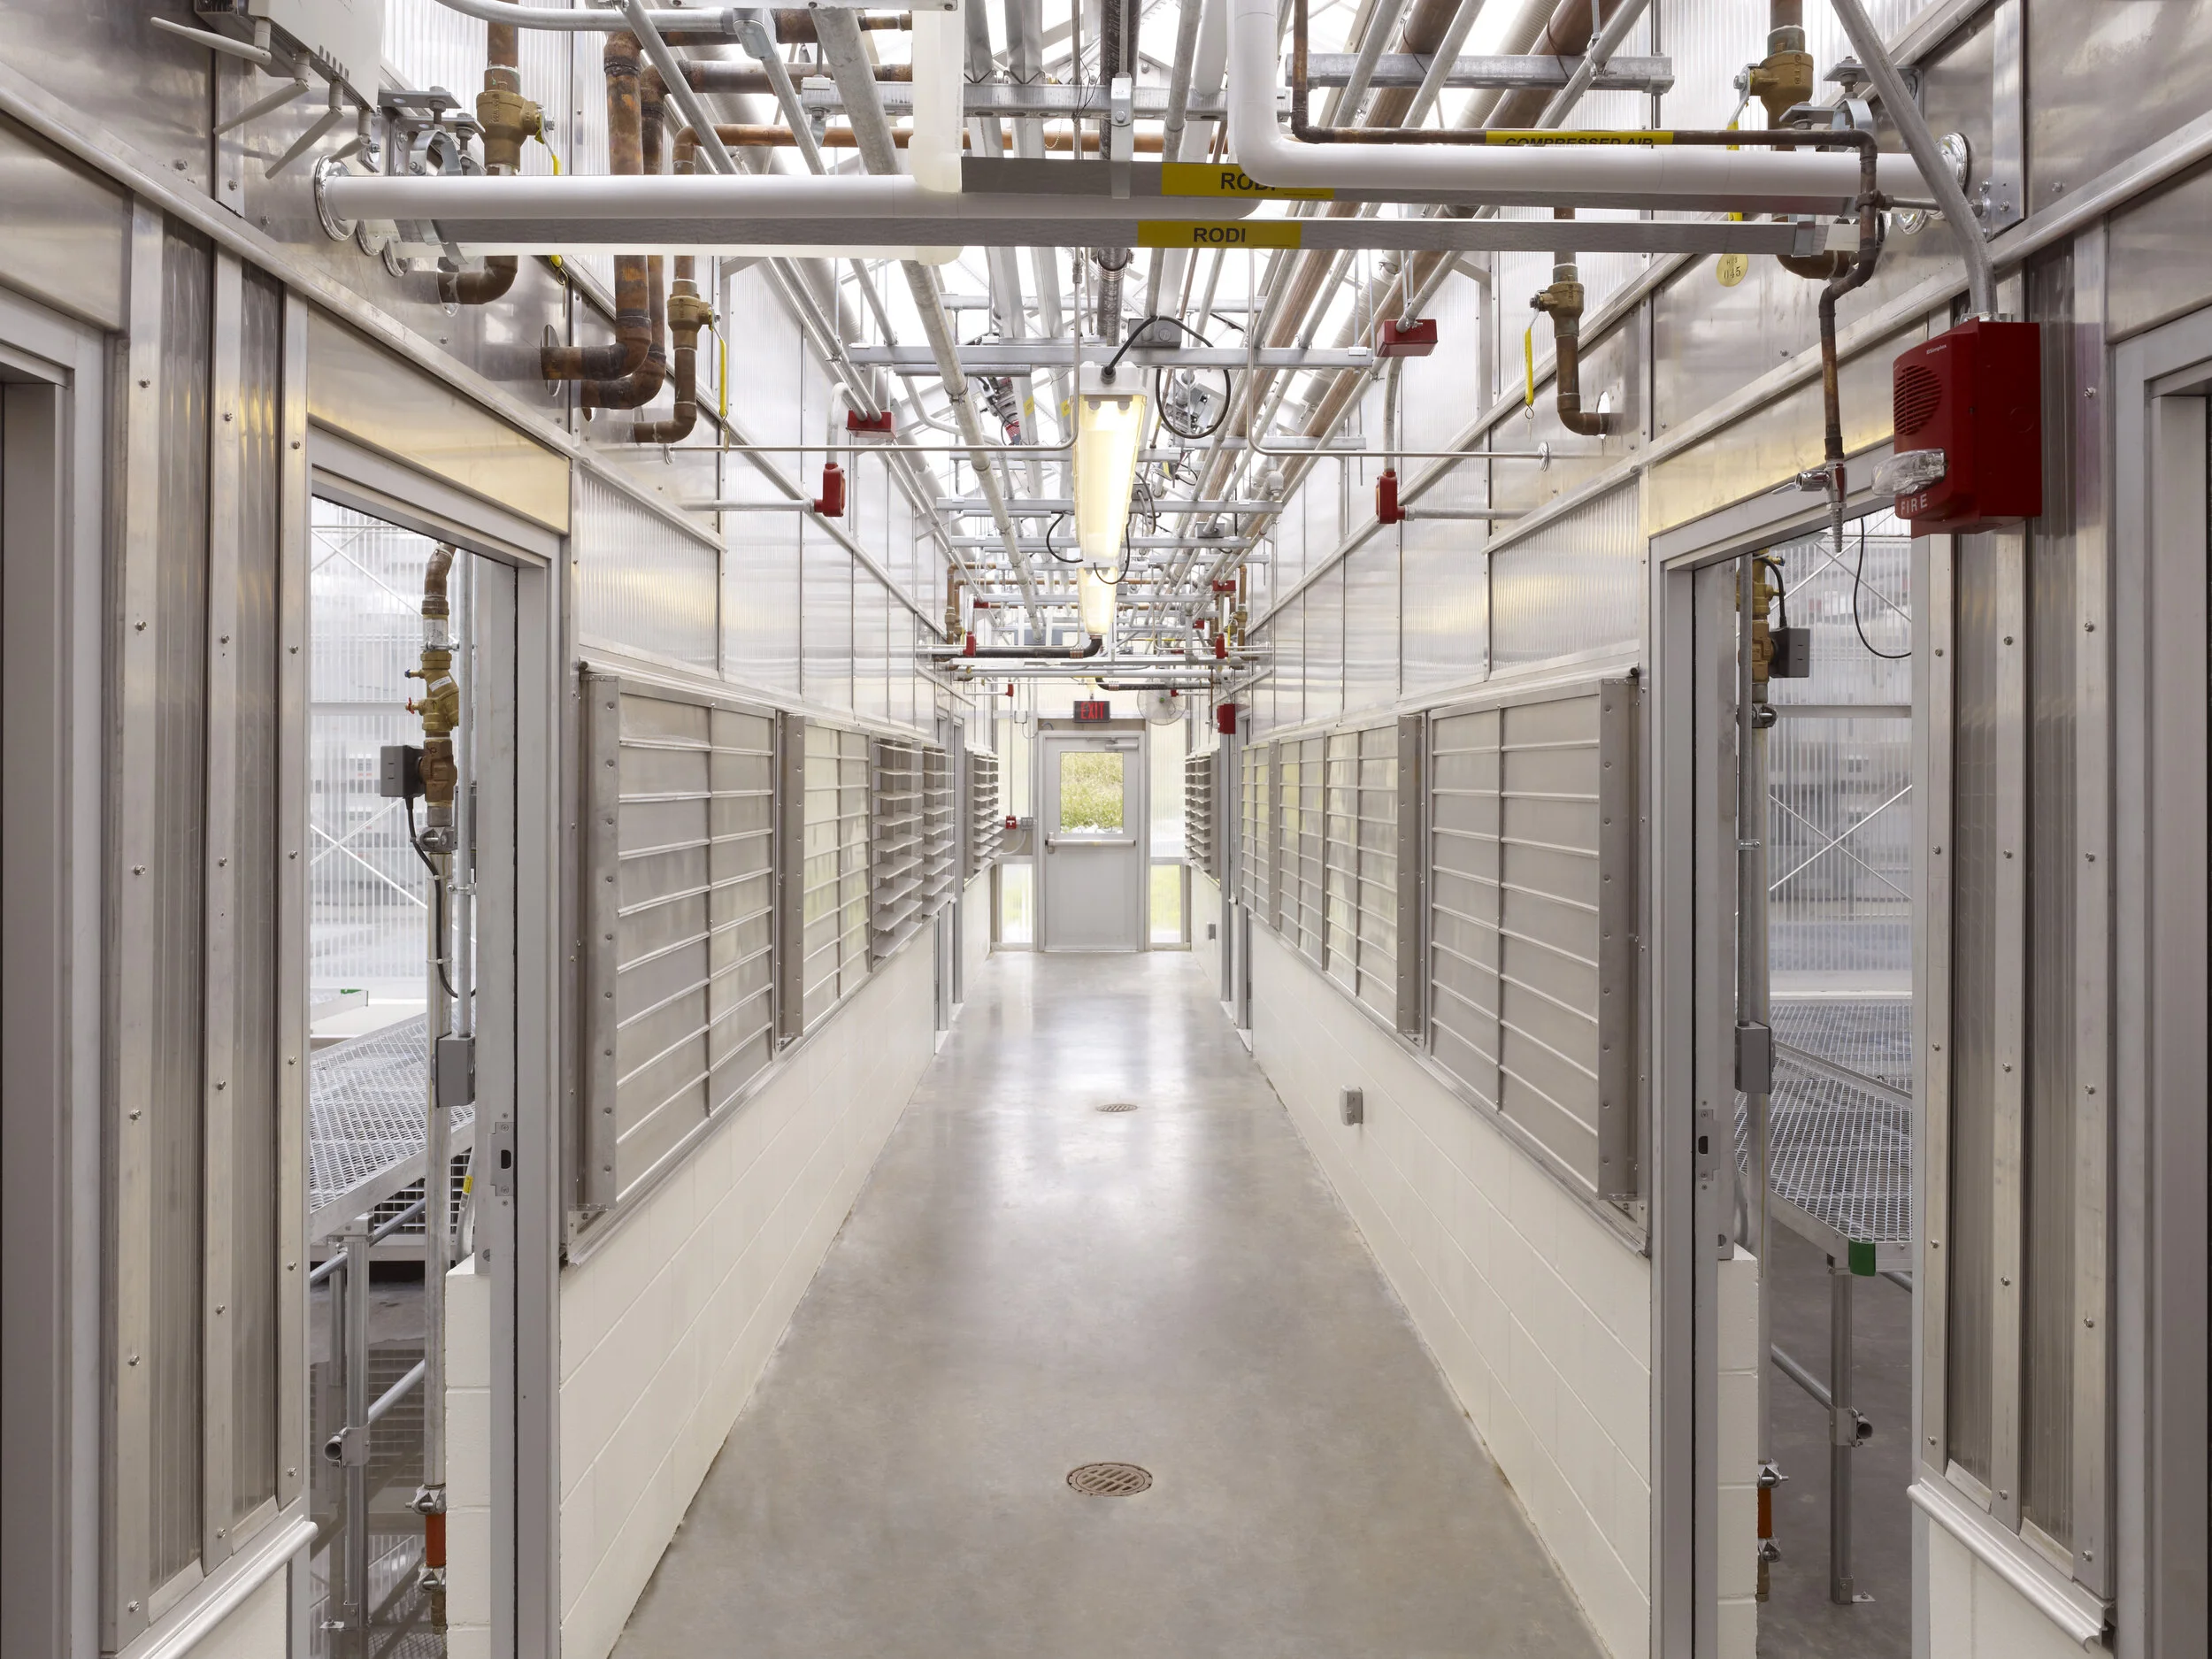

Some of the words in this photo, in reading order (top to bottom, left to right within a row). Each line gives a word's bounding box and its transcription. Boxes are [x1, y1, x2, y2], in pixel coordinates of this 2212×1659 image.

[1220, 172, 1277, 192] RO
[1193, 227, 1247, 243] RODI
[1901, 492, 1929, 516] FIRE
[1080, 702, 1106, 720] EXIT
